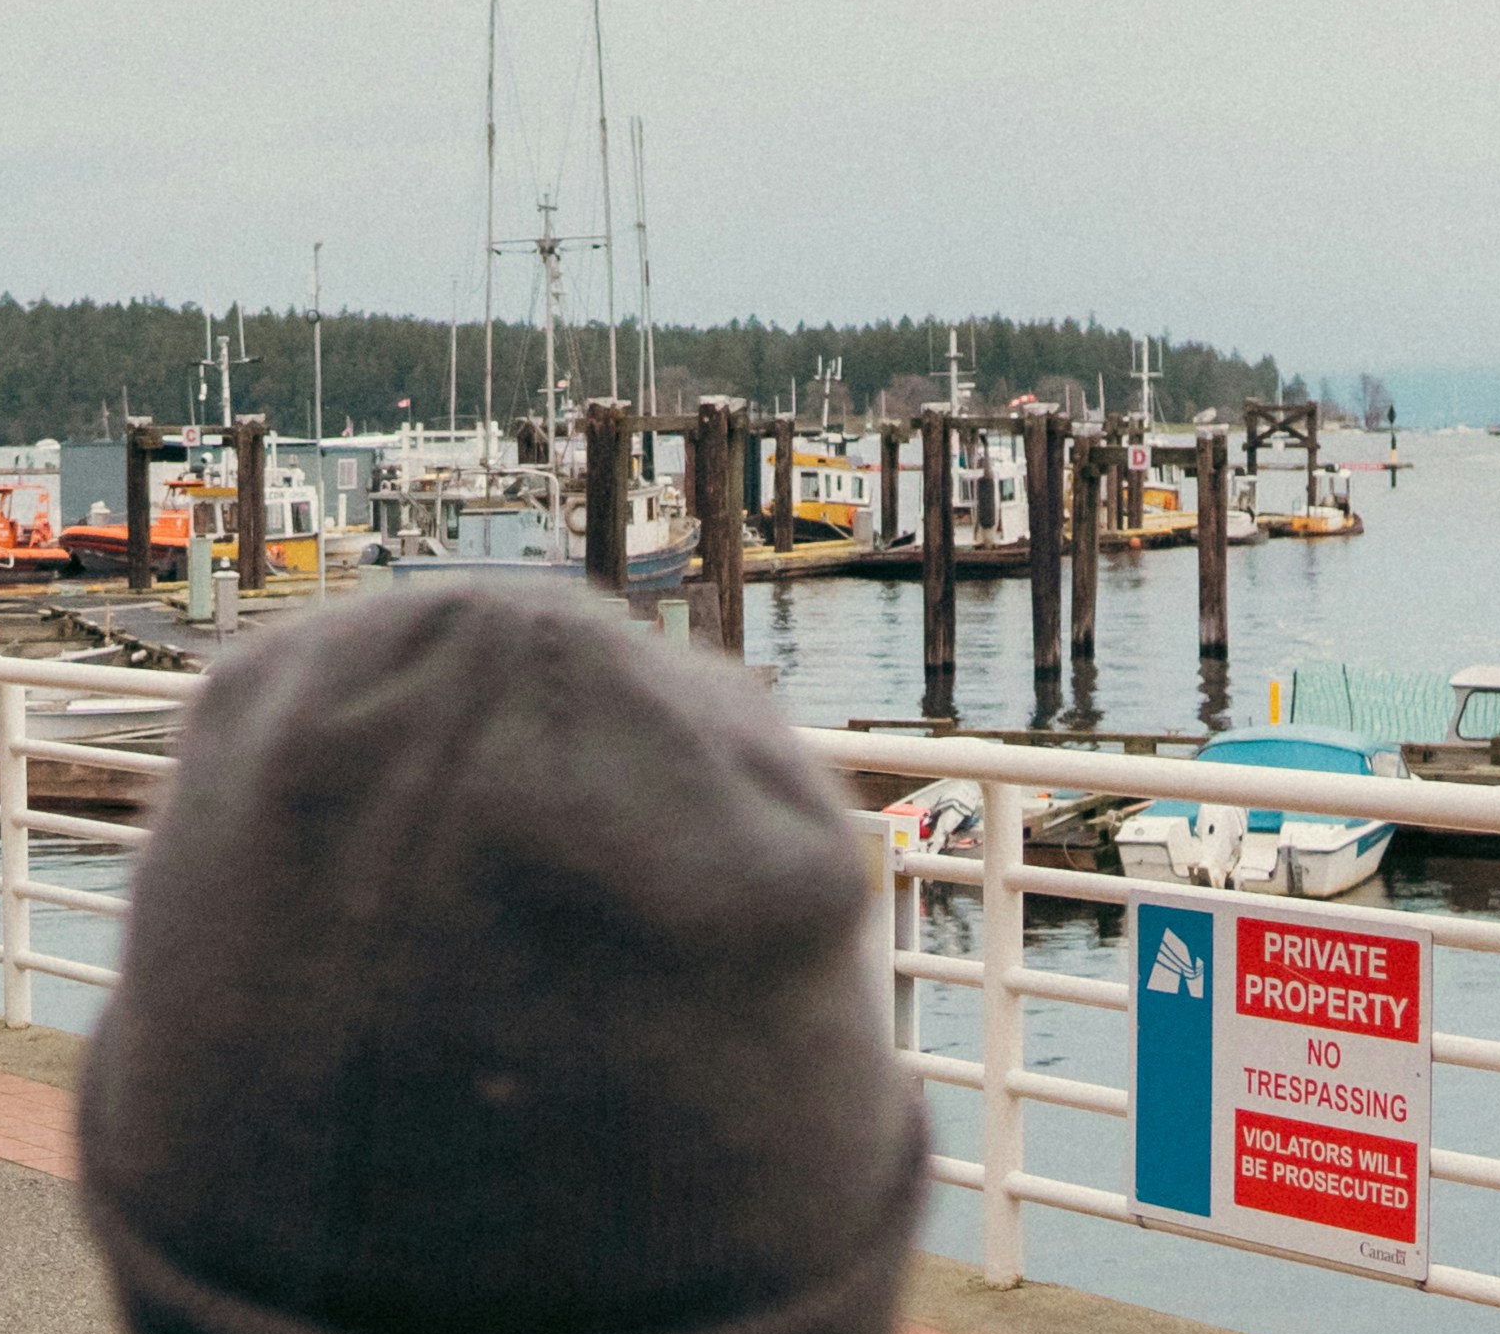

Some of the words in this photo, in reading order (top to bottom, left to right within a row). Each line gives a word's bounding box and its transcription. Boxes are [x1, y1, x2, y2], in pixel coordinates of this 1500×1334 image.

[186, 428, 196, 443] C
[1132, 448, 1146, 466] D
[1264, 931, 1388, 980] PRIVATE
[1245, 973, 1409, 1029] PROPERTY
[1307, 1038, 1341, 1070] NO
[1243, 1067, 1408, 1124] TRESPASSING
[1243, 1125, 1353, 1168] VIOLATORS
[1358, 1148, 1408, 1180] WILL
[1241, 1155, 1268, 1180] BE
[1272, 1161, 1409, 1210] PROSECUTED
[1360, 1241, 1407, 1267] Canada
